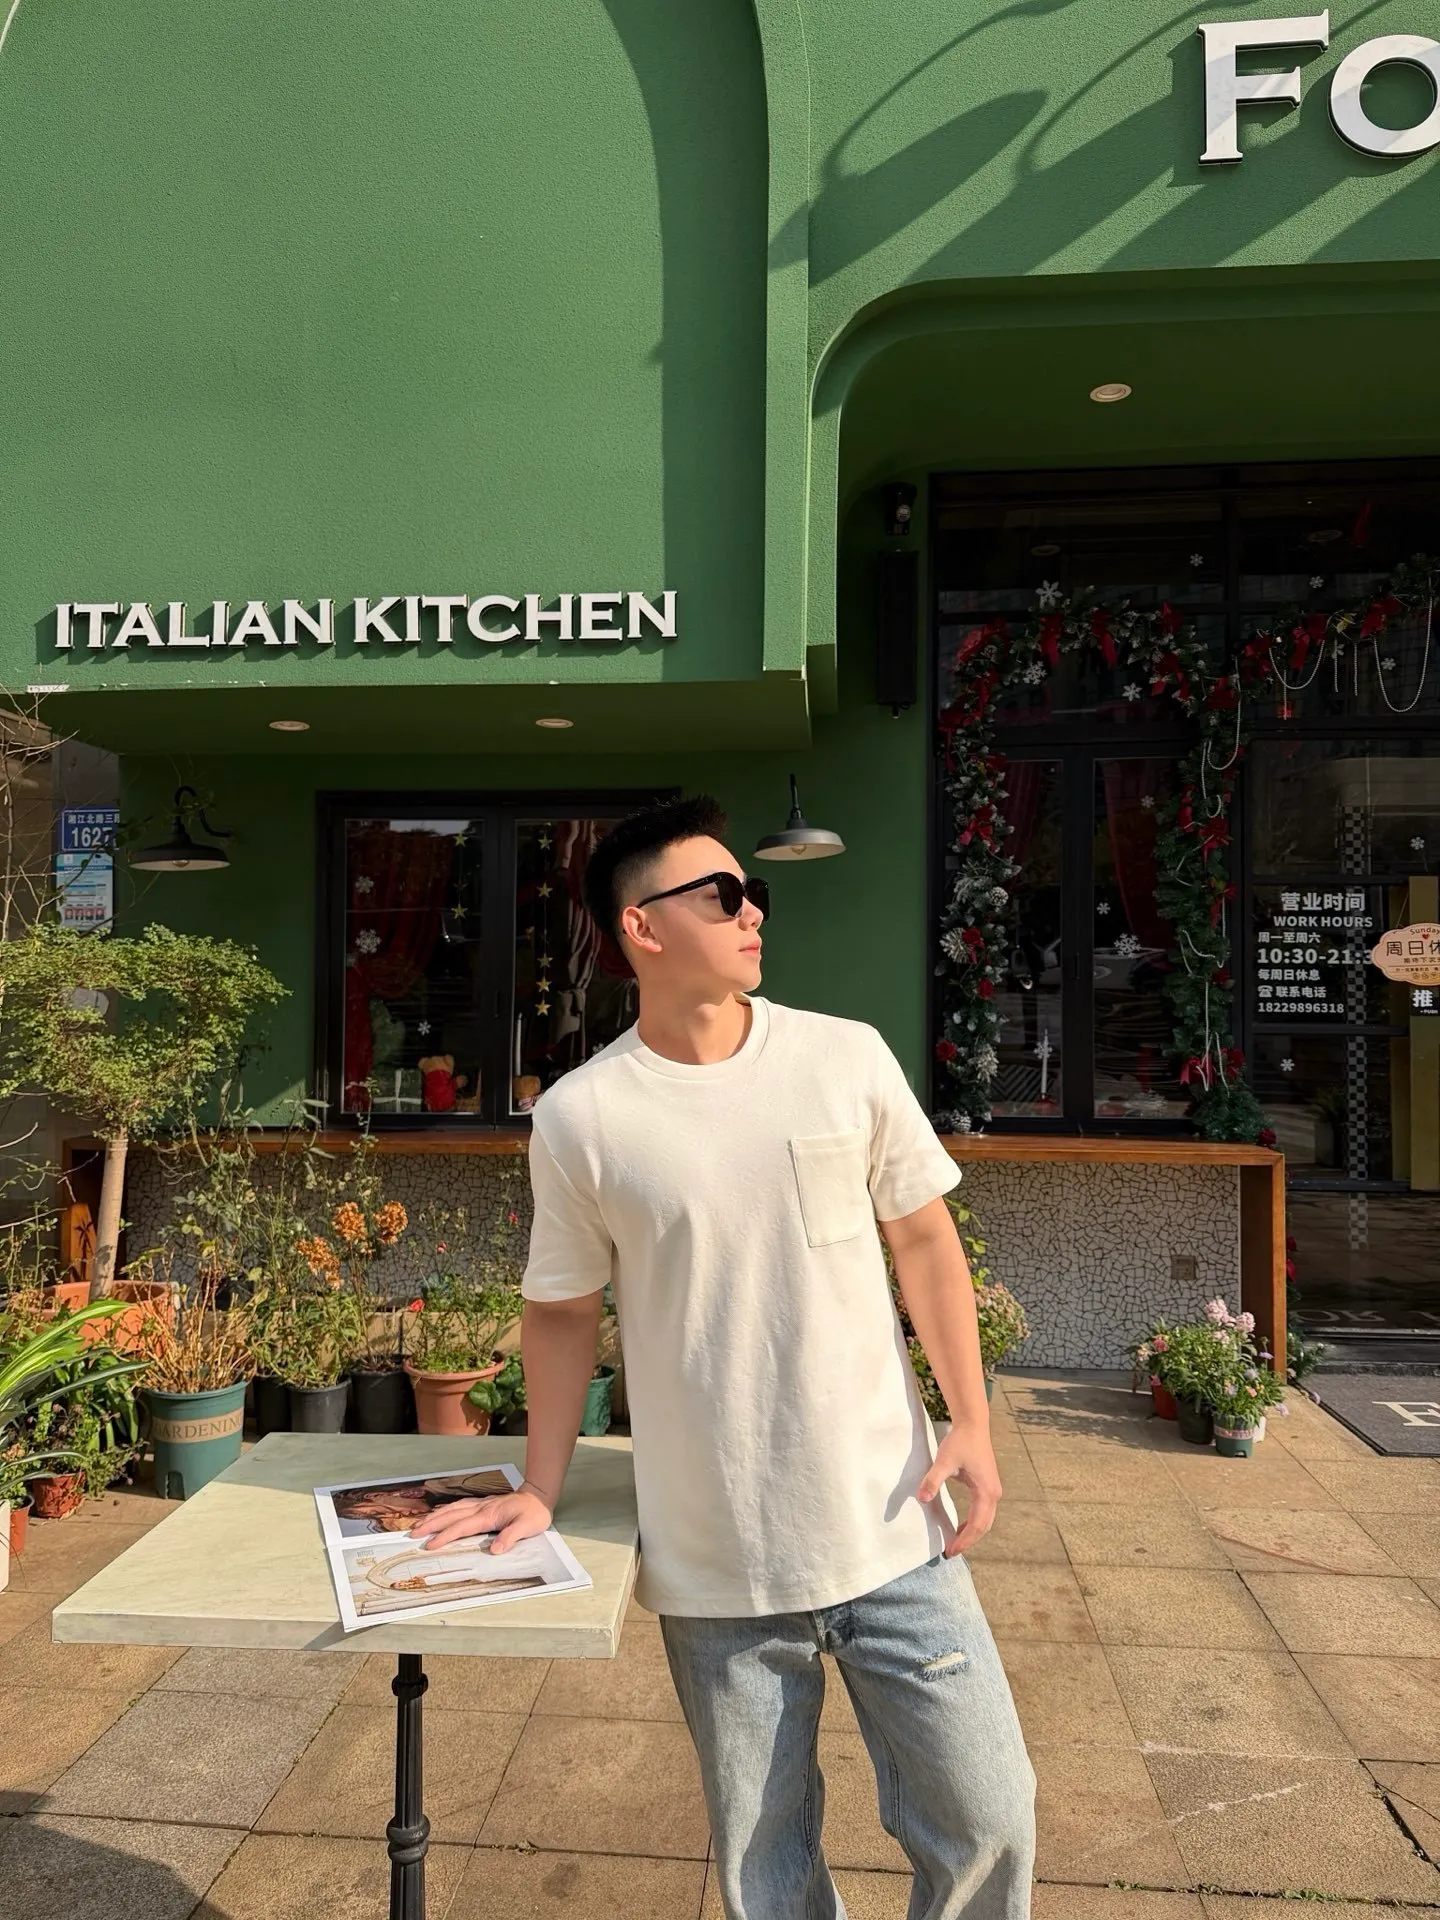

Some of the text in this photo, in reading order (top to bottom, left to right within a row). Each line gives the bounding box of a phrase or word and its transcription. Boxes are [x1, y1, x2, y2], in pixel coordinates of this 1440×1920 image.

[1197, 9, 1440, 157] FO
[55, 590, 678, 649] ITALIAN KITCHEN
[1281, 892, 1365, 912] 营业时间
[1273, 915, 1373, 928] WORK HOURS
[1258, 932, 1321, 944] 周一至周六
[1257, 969, 1321, 981] 每周日休息
[1276, 986, 1327, 998] 联系电话
[1412, 989, 1433, 1007] 推
[1258, 1003, 1345, 1014] 18229896318
